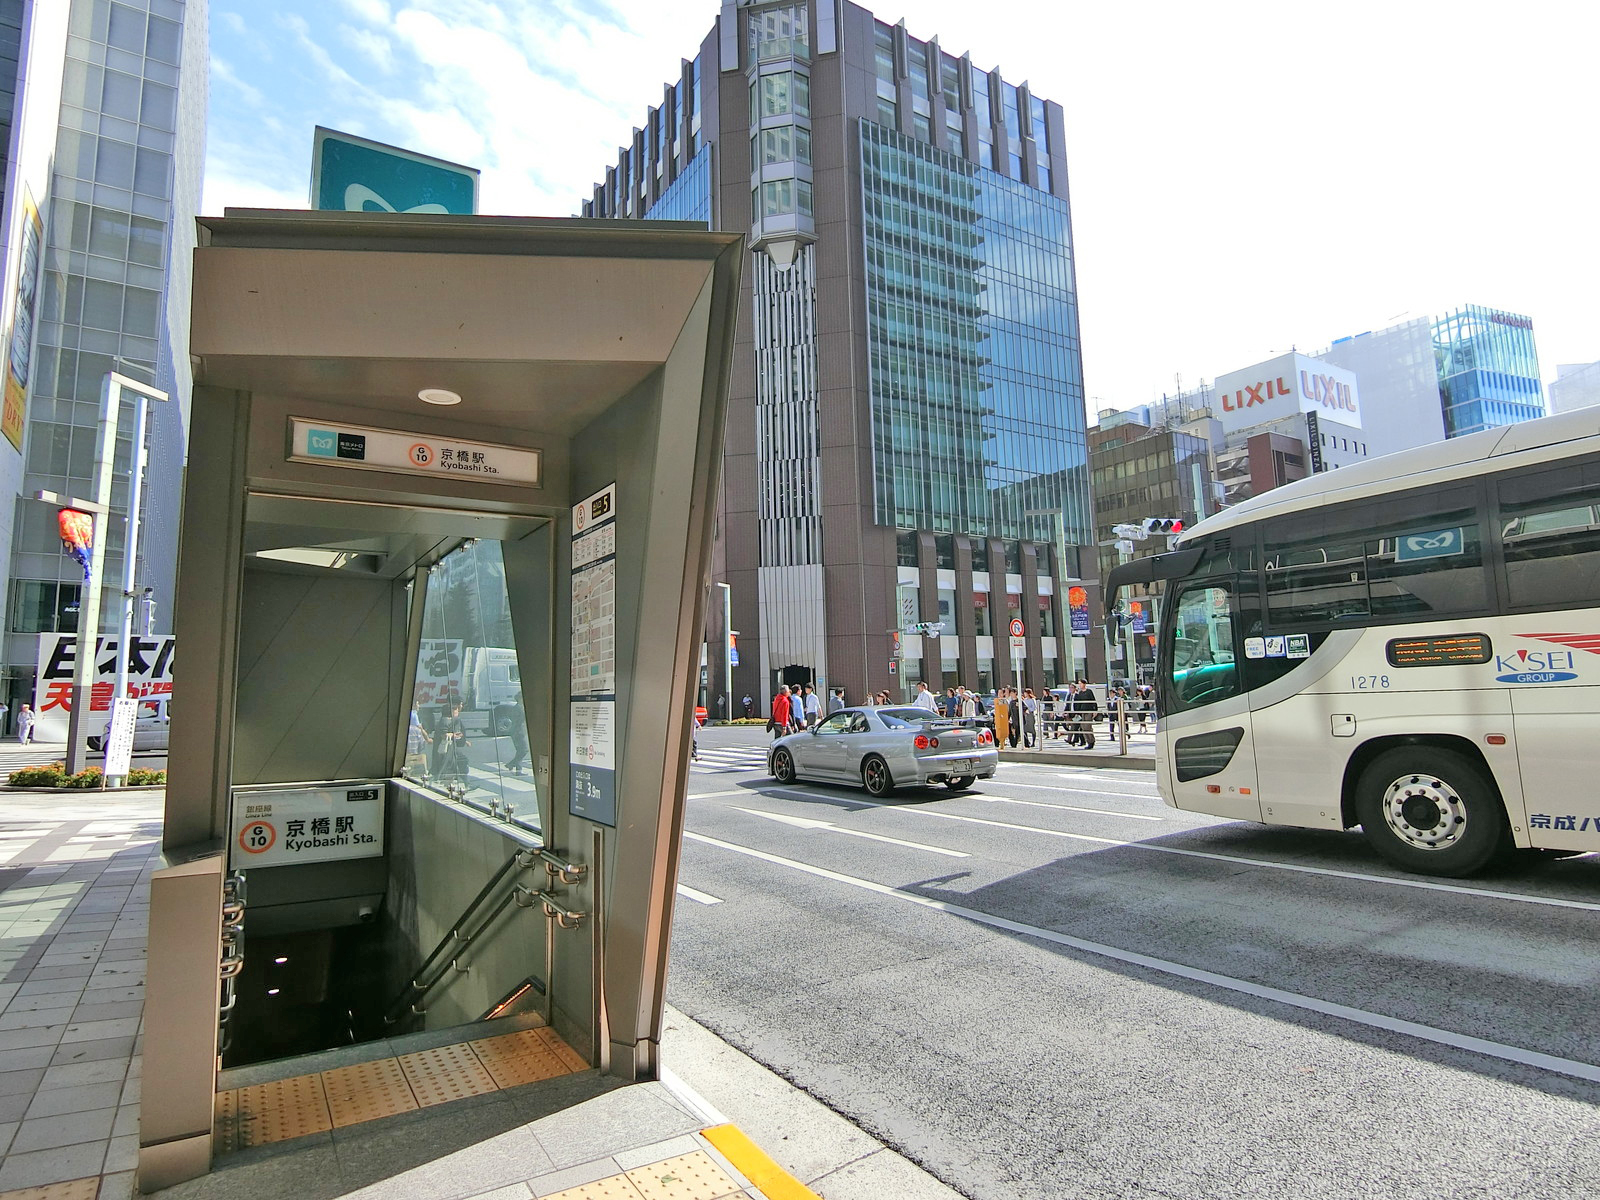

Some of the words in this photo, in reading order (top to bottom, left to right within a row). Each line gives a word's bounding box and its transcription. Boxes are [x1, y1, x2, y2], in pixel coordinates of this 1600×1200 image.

[1491, 313, 1533, 330] KONAMI
[1222, 377, 1290, 412] LIXIL
[1300, 370, 1356, 412] LIXIL
[416, 454, 428, 462] 10
[441, 448, 485, 464] 京橋駅
[440, 460, 481, 472] Kyobashi
[483, 465, 500, 474] Sta.
[603, 495, 609, 512] 5
[1351, 676, 1390, 689] 1278
[1517, 673, 1555, 683] GROUP
[367, 790, 374, 800] 5
[587, 781, 601, 799] 3.9m
[286, 816, 354, 838] 京橋駅
[1530, 813, 1600, 832] 京成バ
[253, 826, 264, 836] G
[250, 836, 267, 847] 10
[285, 834, 349, 852] Kyobashi
[353, 833, 377, 845] Sta.
